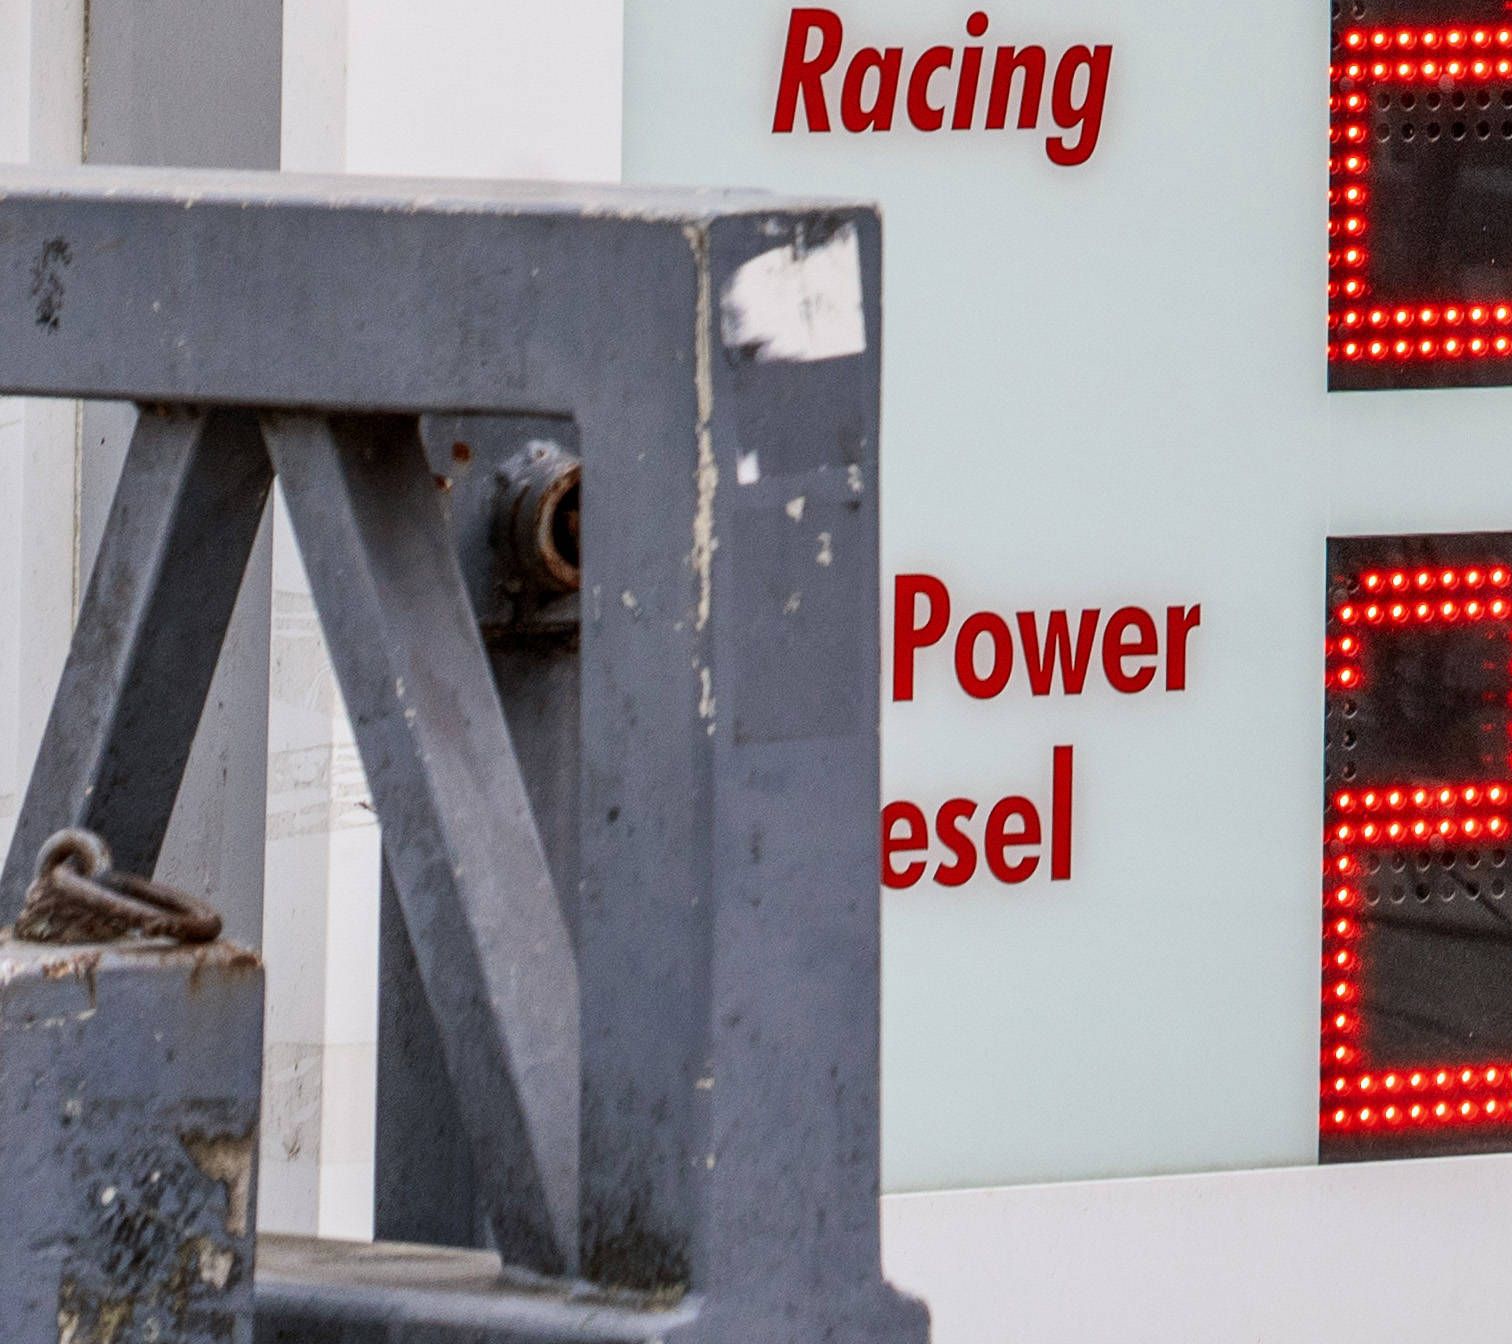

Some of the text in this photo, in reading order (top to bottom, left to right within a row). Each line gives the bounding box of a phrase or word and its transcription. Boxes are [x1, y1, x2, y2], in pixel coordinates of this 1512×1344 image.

[773, 8, 1113, 166] Racing
[892, 573, 1201, 702] Power
[881, 745, 1074, 889] esel
